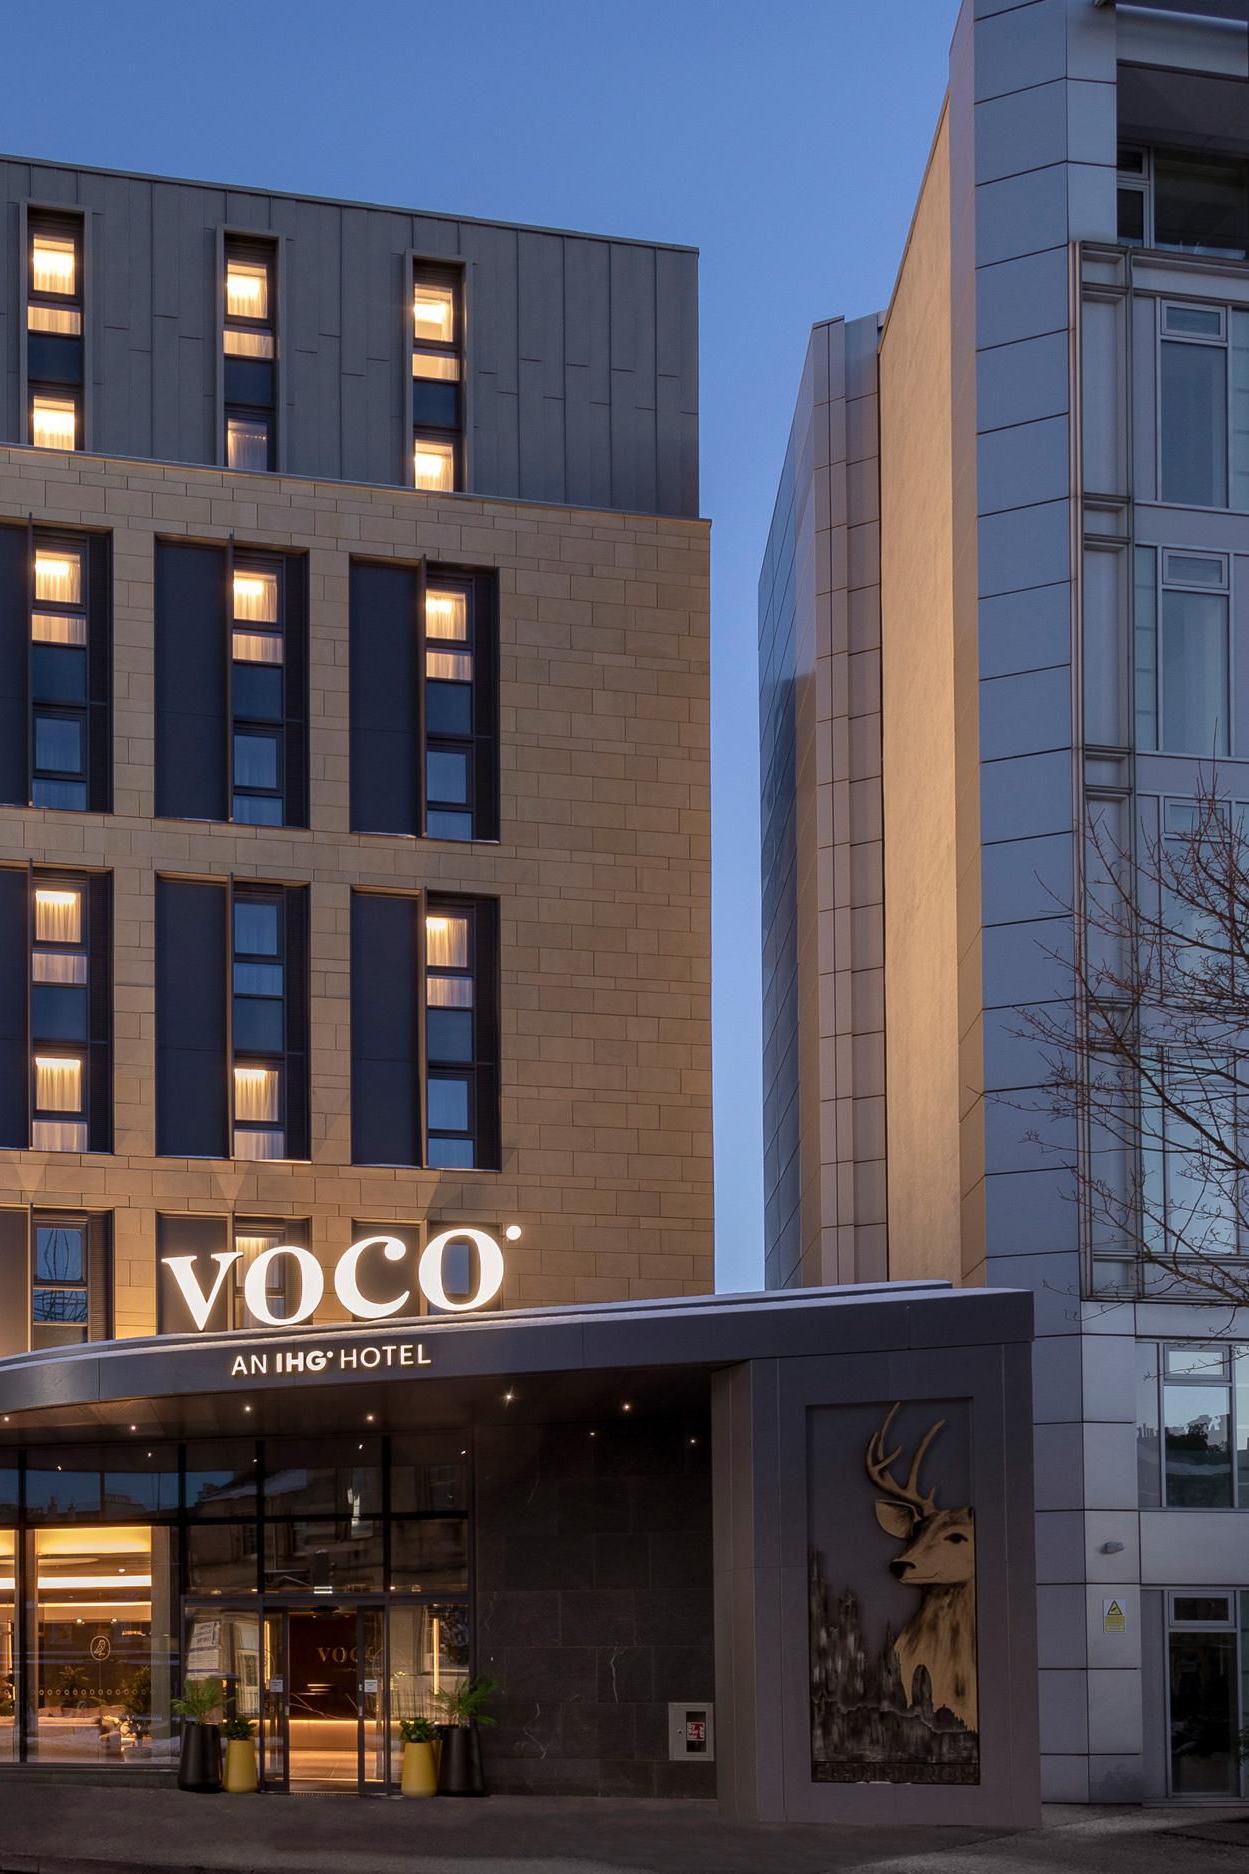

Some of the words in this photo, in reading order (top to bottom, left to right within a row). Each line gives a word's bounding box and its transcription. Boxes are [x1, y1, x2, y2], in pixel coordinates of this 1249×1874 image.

[231, 1353, 267, 1376] AN
[275, 1351, 327, 1373] IHG
[340, 1343, 432, 1369] HOTEL
